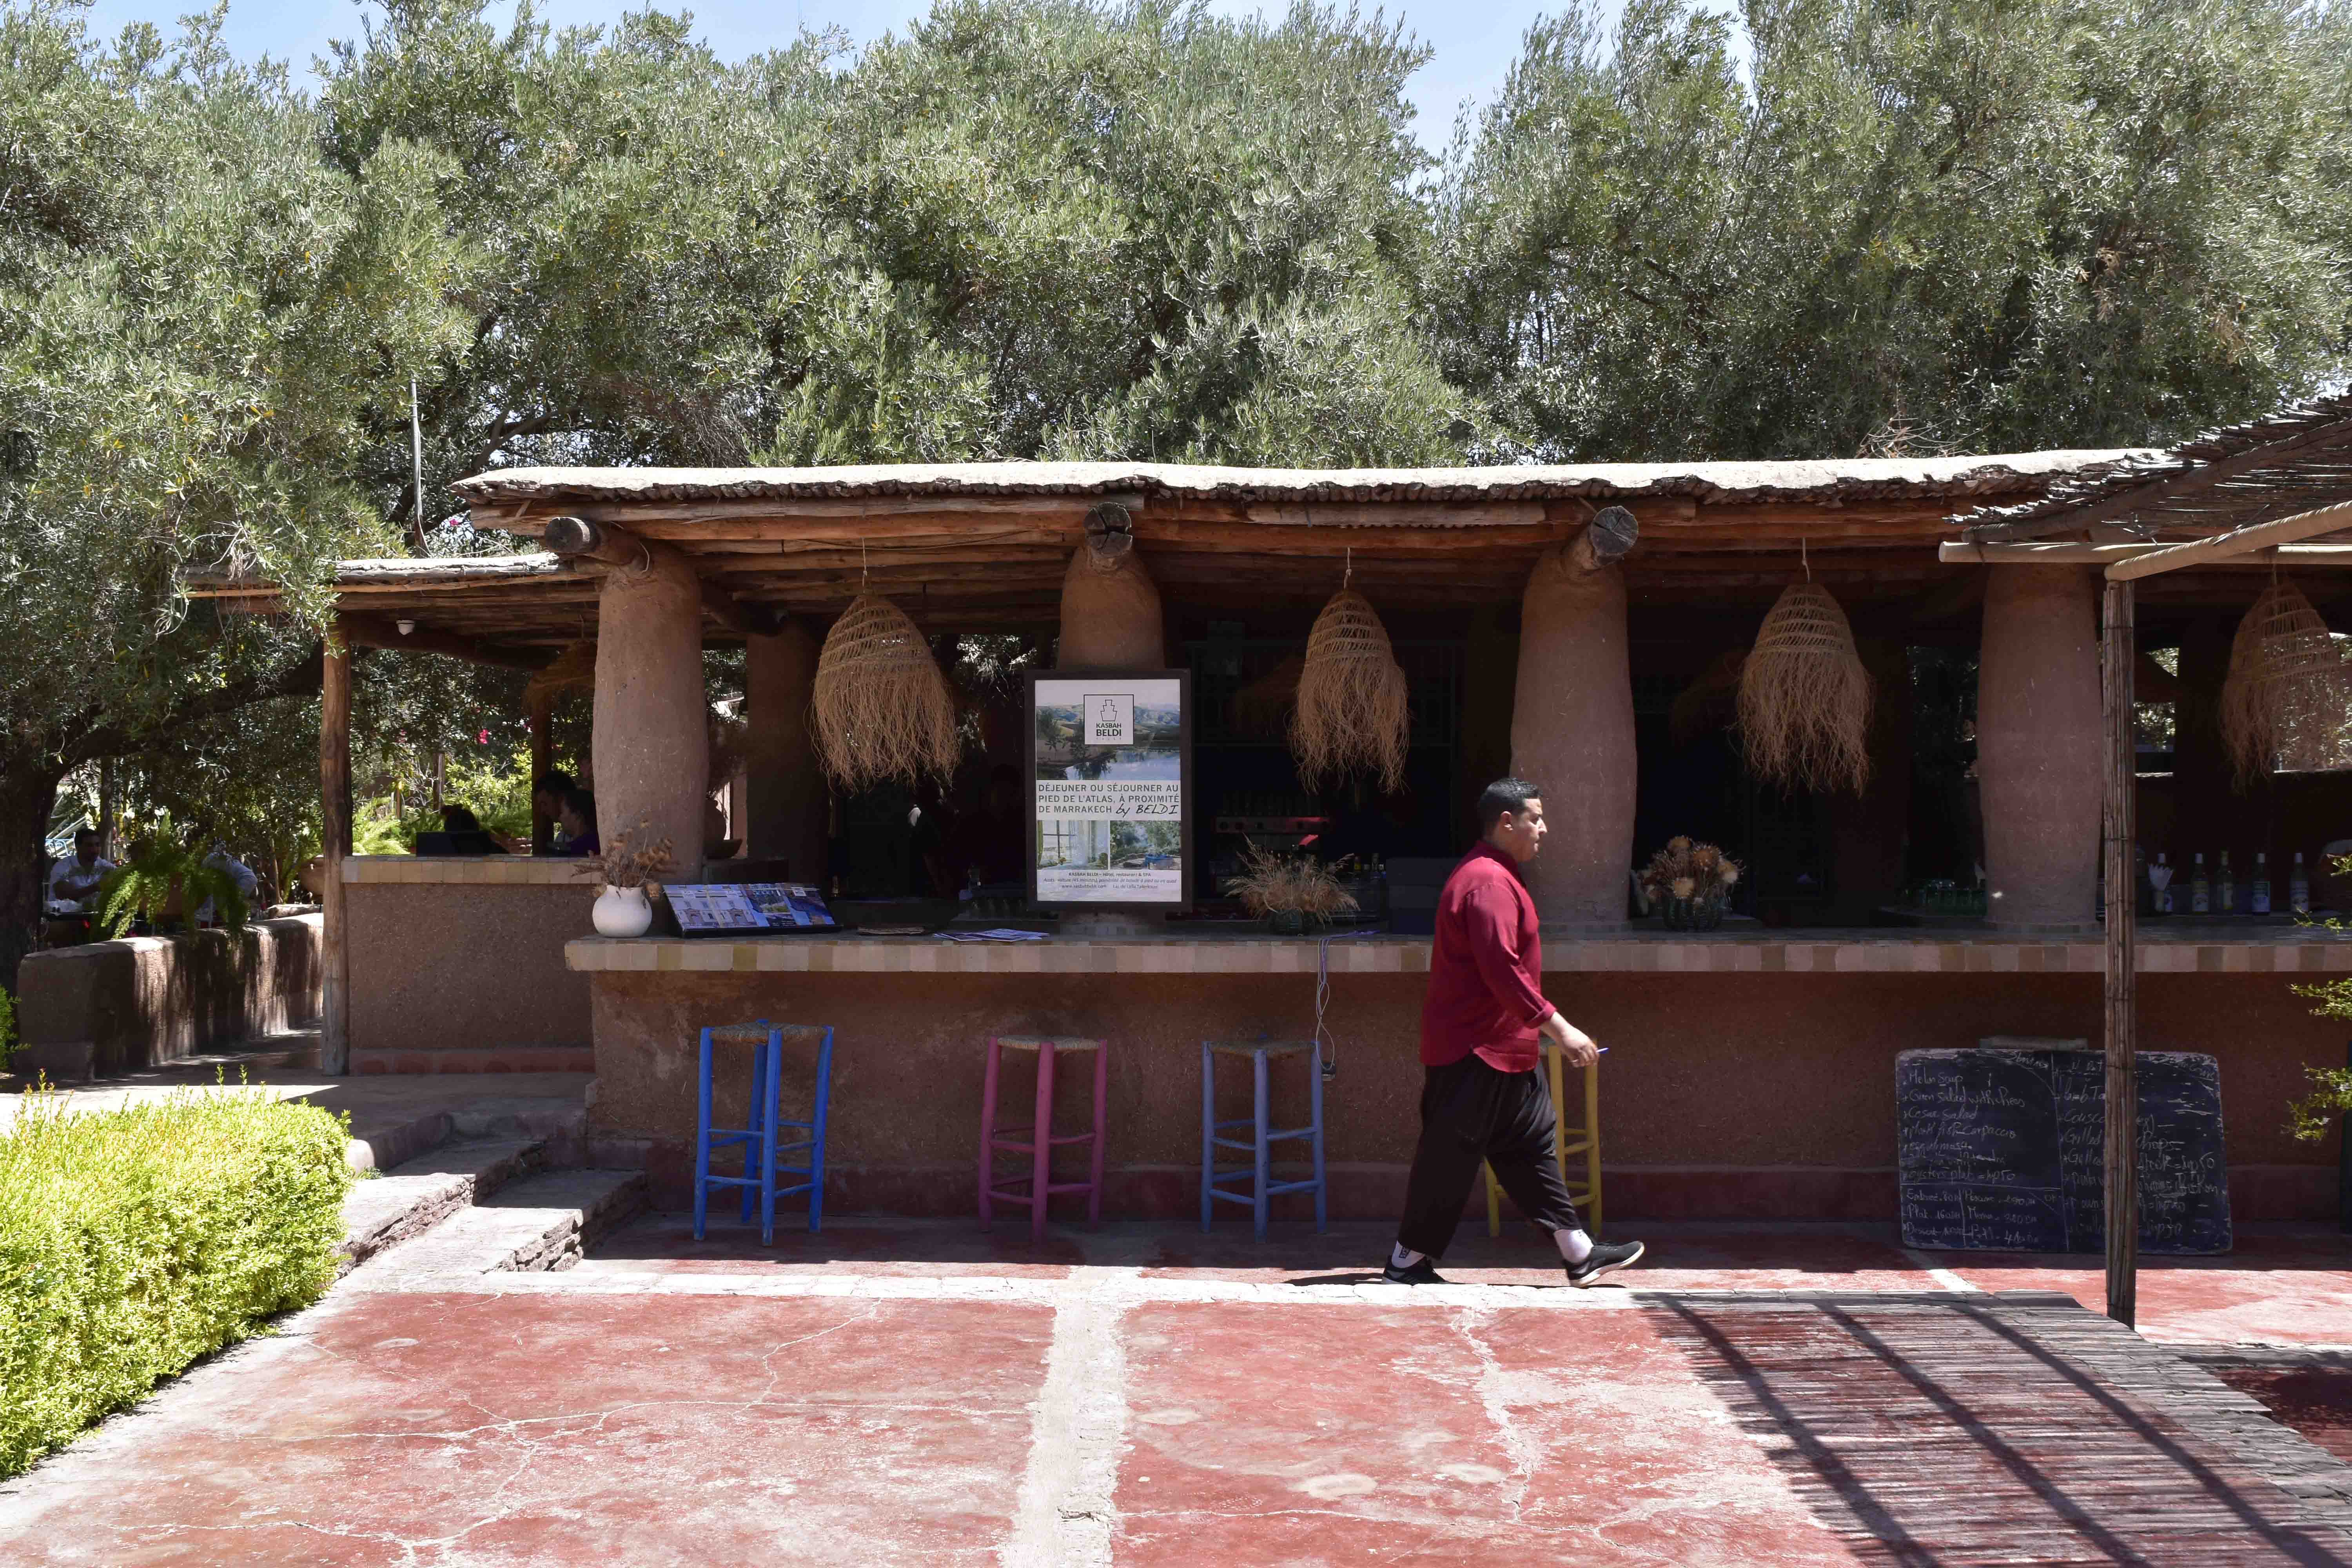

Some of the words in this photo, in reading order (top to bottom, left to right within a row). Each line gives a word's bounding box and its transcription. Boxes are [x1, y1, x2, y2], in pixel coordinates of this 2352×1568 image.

[1038, 782, 1087, 792] DÉJEUNER
[1107, 782, 1162, 792] SÉJOURNER
[1078, 795, 1115, 804] L'ATLAS,
[1119, 793, 1125, 802] À
[1129, 793, 1180, 803] PROXIMITÉ
[1116, 803, 1131, 818] by
[1135, 804, 1179, 815] BELDI
